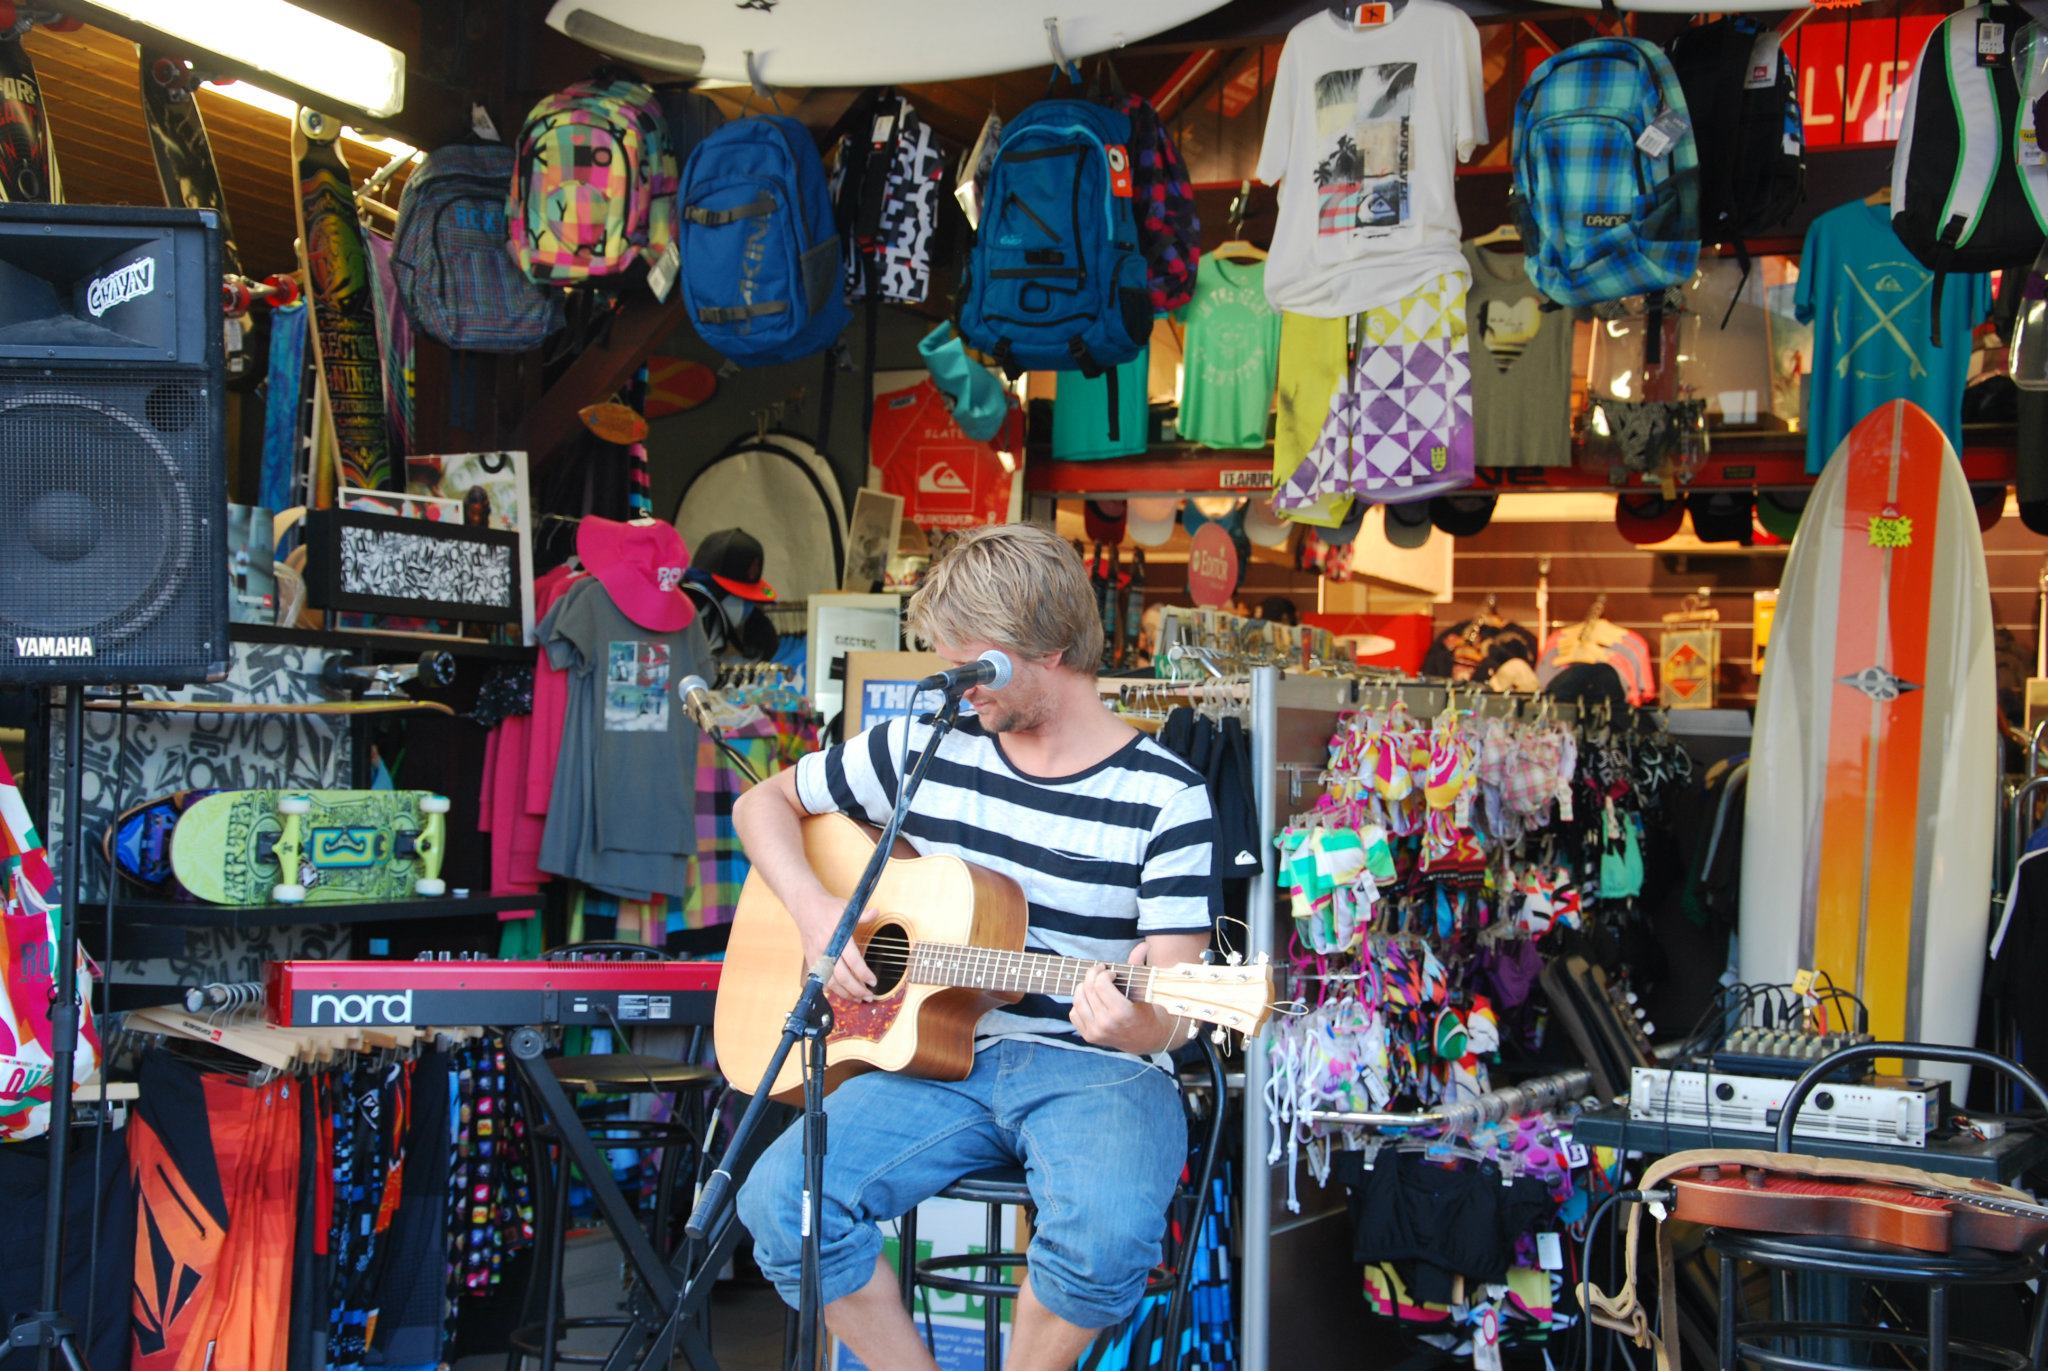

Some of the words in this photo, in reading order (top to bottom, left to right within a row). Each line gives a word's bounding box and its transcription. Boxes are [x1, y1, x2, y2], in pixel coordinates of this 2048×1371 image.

[16, 636, 94, 657] YAMAHA
[834, 634, 878, 649] ELECTRIC
[311, 989, 413, 1024] nord
